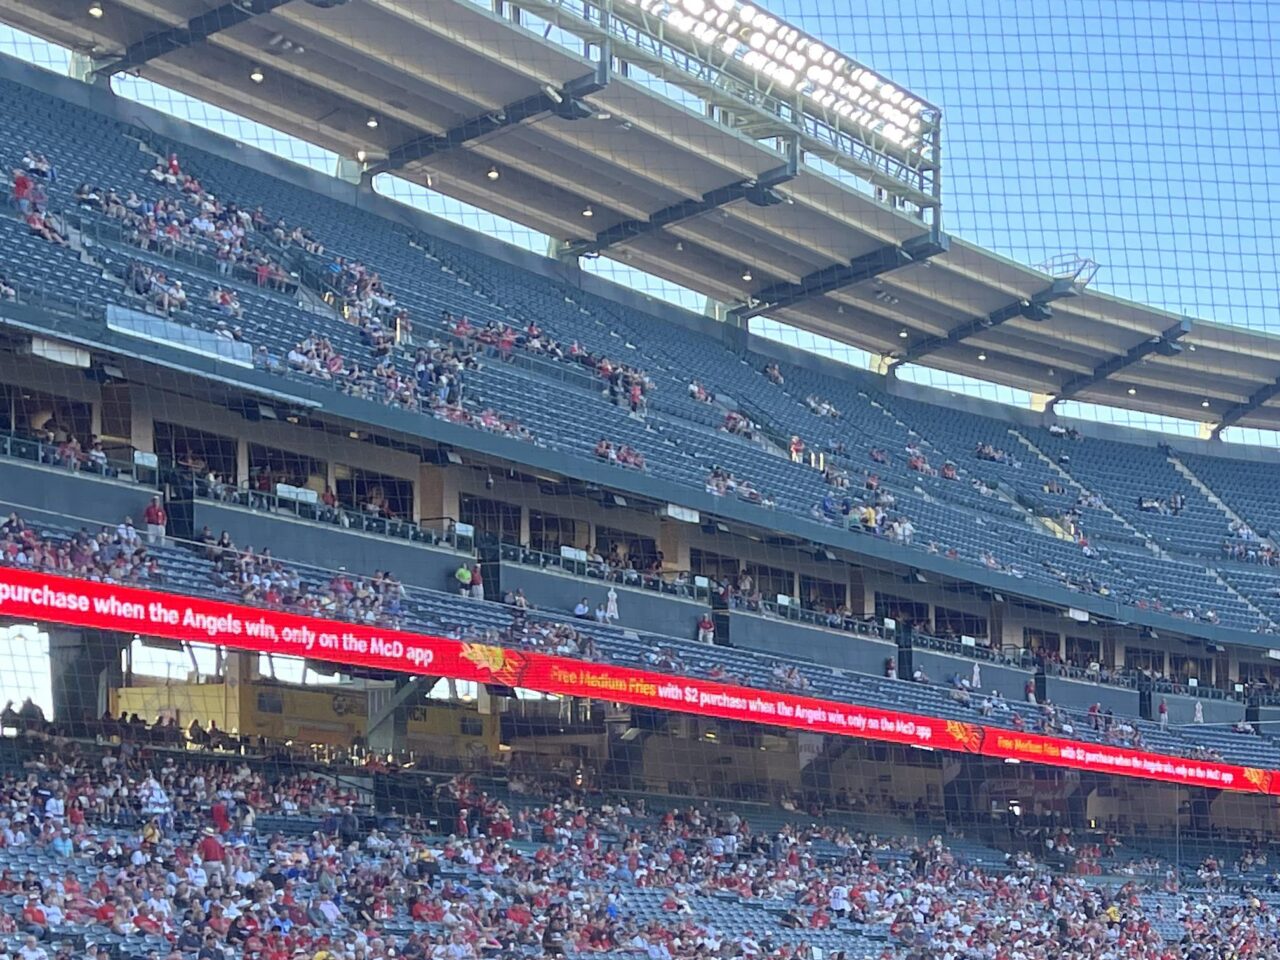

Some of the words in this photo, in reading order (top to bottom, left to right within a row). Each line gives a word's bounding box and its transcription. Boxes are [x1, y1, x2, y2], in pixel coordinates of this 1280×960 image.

[94, 597, 145, 619] when
[149, 603, 179, 624] the
[183, 608, 241, 635] Angels
[245, 617, 279, 642] win,
[282, 626, 315, 649] only
[319, 634, 338, 649] on
[342, 634, 366, 652] the
[370, 638, 403, 657] McD
[406, 647, 433, 667] app
[551, 665, 577, 684] Free
[580, 671, 627, 691] Medium
[629, 678, 656, 696] Fries
[658, 683, 682, 700] with
[685, 687, 698, 703] $2
[700, 692, 747, 710] purchase
[749, 698, 775, 715] when
[777, 701, 794, 717] the
[795, 705, 827, 724] Angels
[848, 713, 866, 731] only
[880, 718, 895, 732] the
